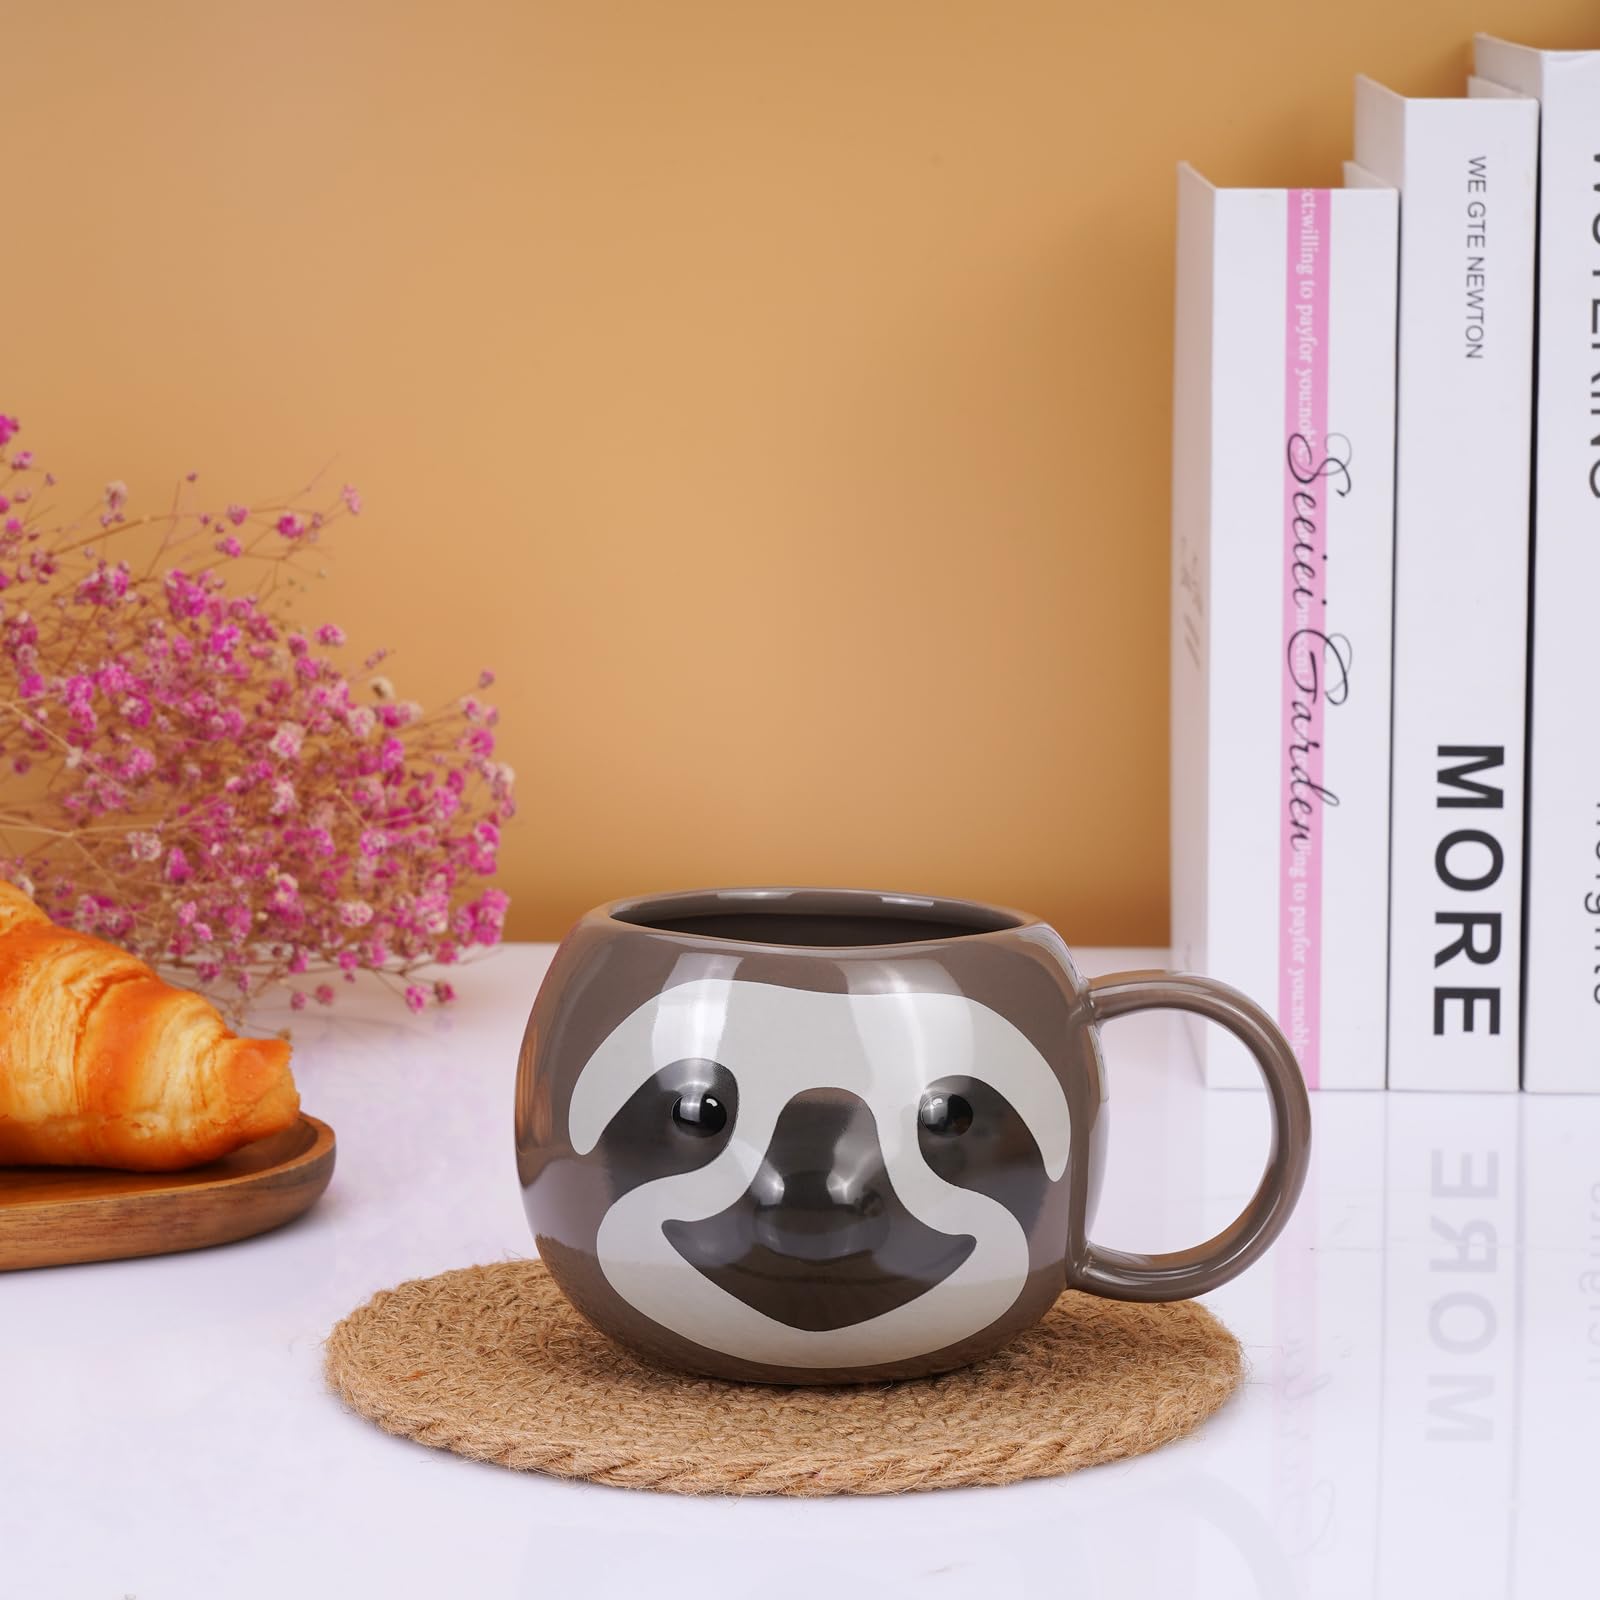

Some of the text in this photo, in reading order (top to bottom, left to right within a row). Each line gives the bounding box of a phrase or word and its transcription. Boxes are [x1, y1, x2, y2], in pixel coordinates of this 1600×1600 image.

[1296, 187, 1319, 275] ct:willing
[1299, 280, 1316, 298] to
[1464, 156, 1487, 359] WE GTE NEWTON
[1287, 628, 1353, 852] Garden
[1293, 882, 1309, 901] to
[1433, 745, 1505, 1036] MORE
